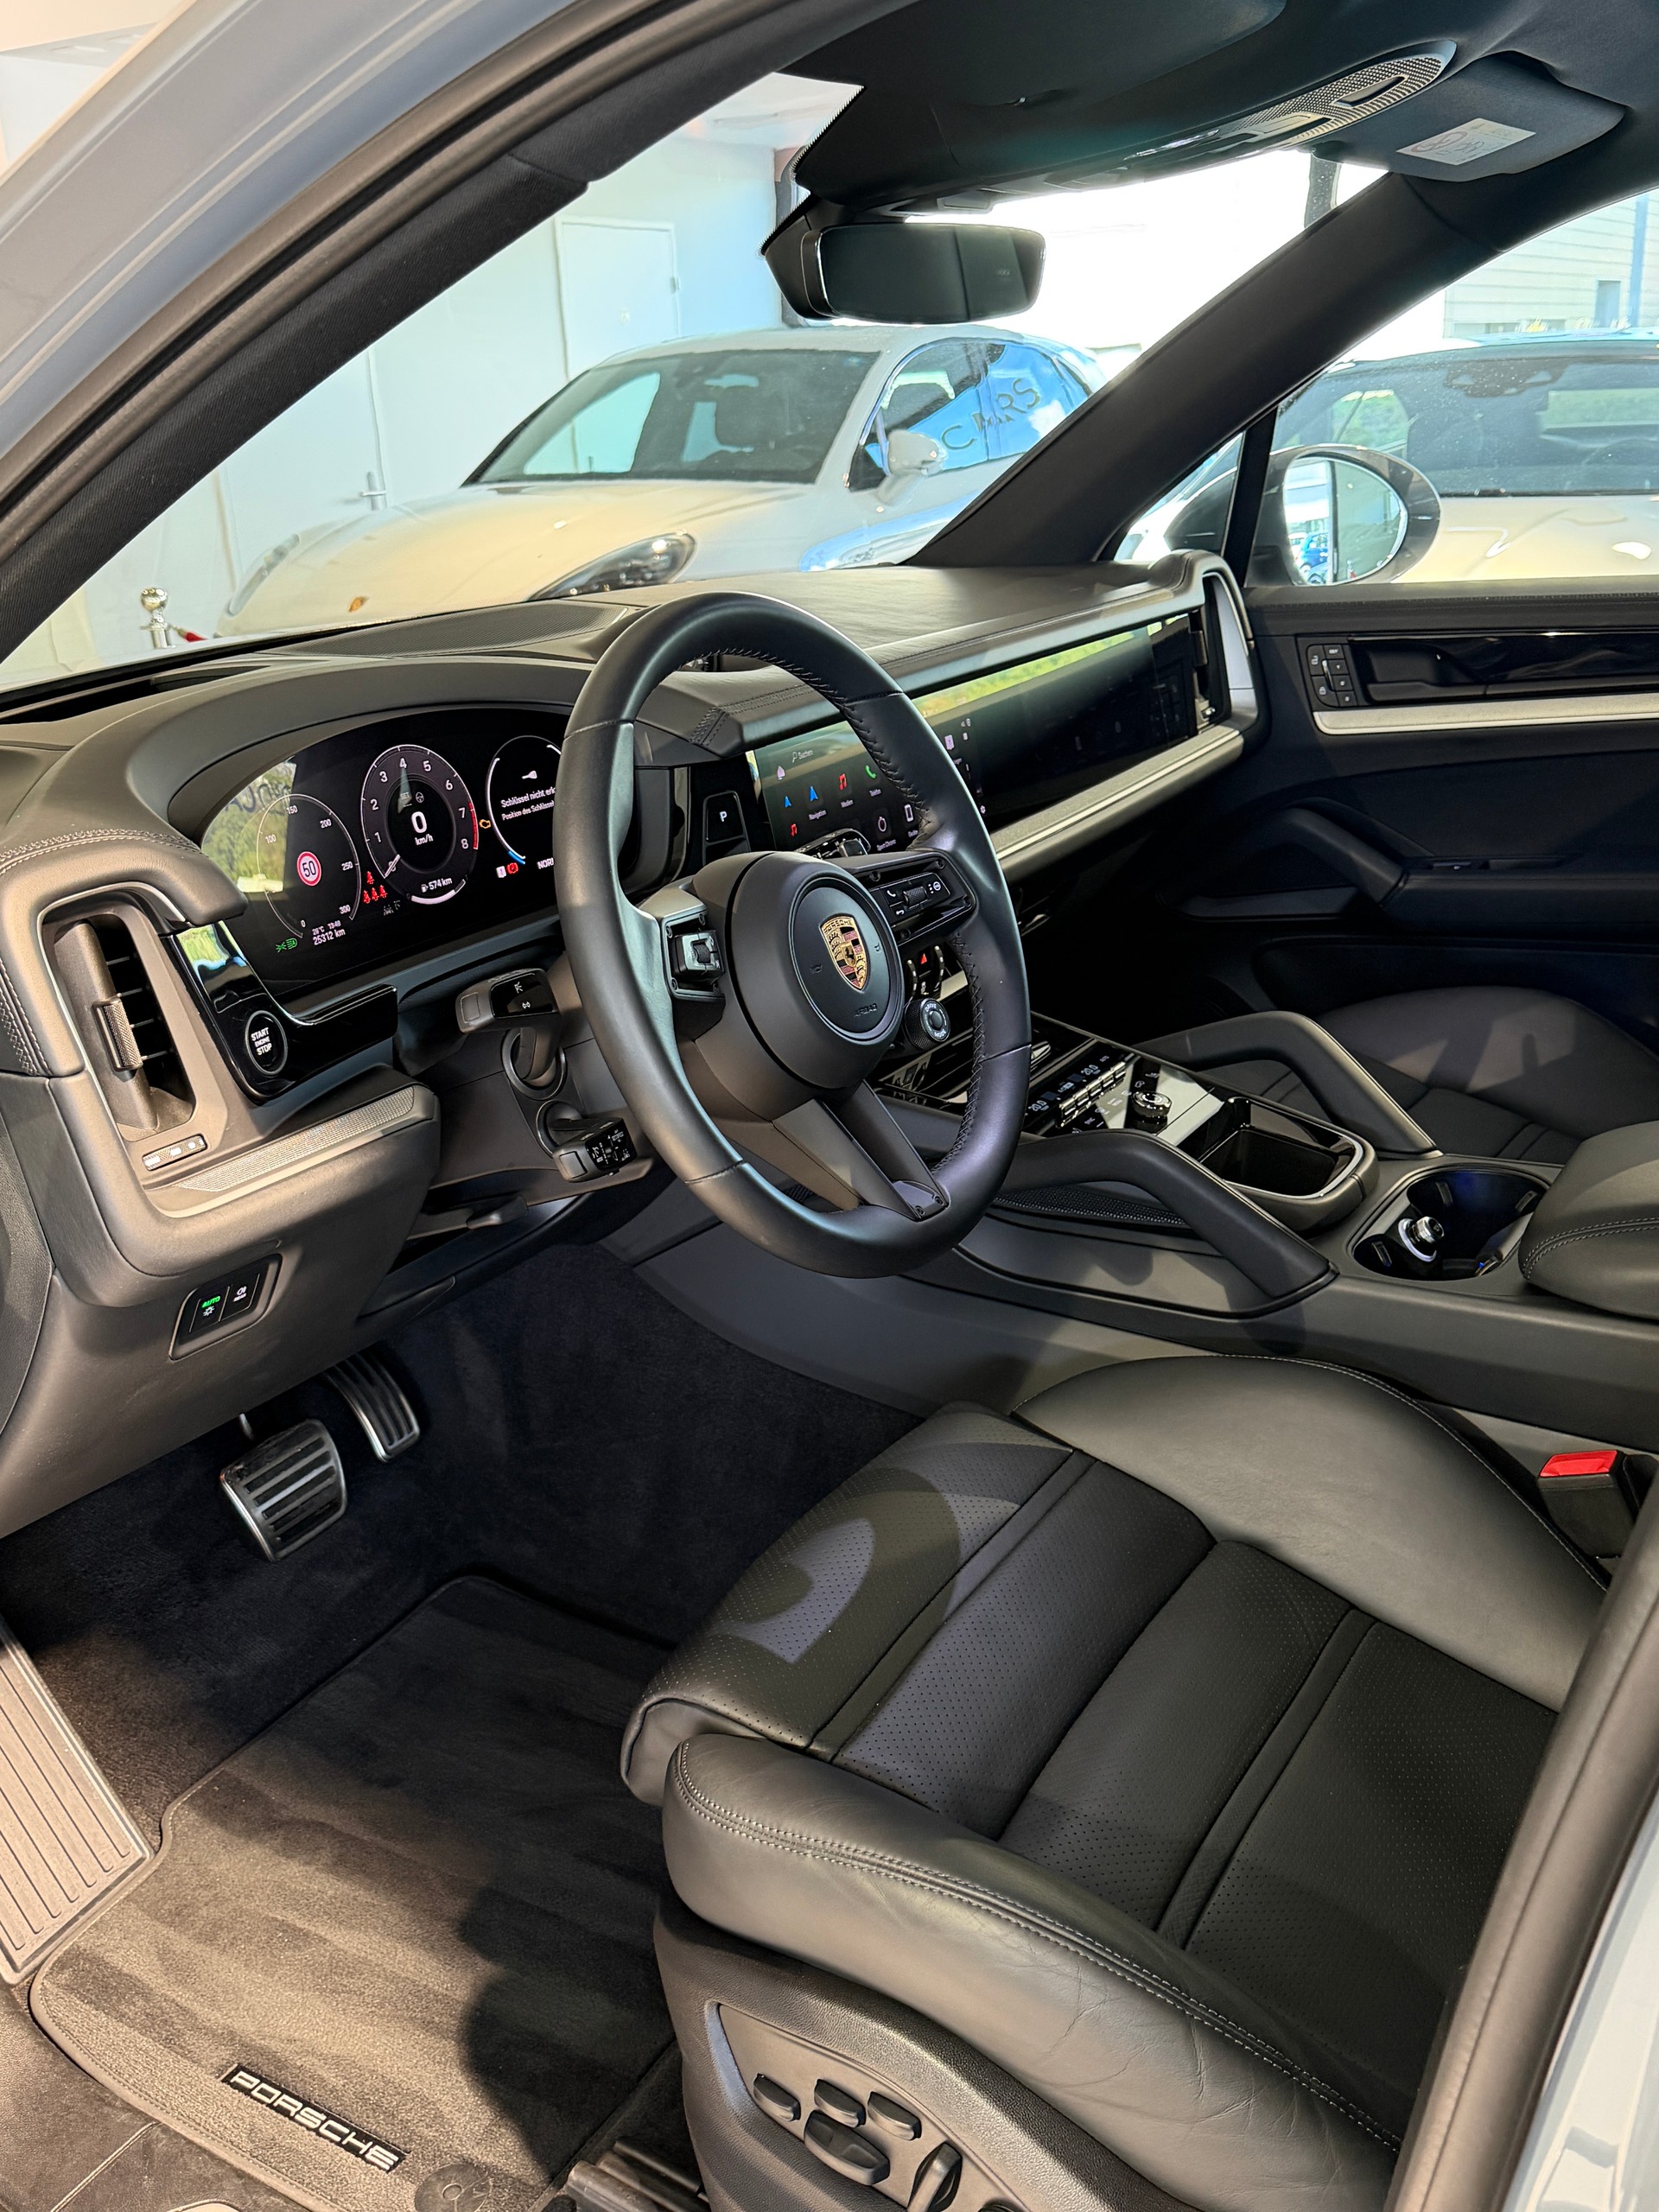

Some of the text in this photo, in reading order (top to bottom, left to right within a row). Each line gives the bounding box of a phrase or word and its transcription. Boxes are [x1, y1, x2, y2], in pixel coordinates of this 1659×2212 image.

[399, 757, 407, 769] 4
[423, 760, 431, 772] 5
[379, 771, 388, 782] 3
[445, 779, 454, 791] 6
[286, 804, 298, 815] 150
[370, 798, 378, 810] 2
[458, 807, 466, 818] 7
[719, 810, 728, 822] P
[320, 818, 332, 829] 200
[410, 810, 428, 834] 0
[264, 834, 276, 844] 100
[374, 831, 381, 842] 1
[415, 833, 434, 845] km/h
[461, 838, 469, 849] 8
[302, 861, 317, 877] 50
[341, 861, 353, 871] 250
[429, 879, 442, 891] 574
[441, 877, 453, 887] km
[301, 919, 306, 928] 0
[313, 929, 346, 945] 25312 km
[251, 1027, 270, 1041] START
[256, 1042, 272, 1056] STOP
[201, 1295, 221, 1308] AUTO
[230, 2070, 399, 2171] PORSCHE
